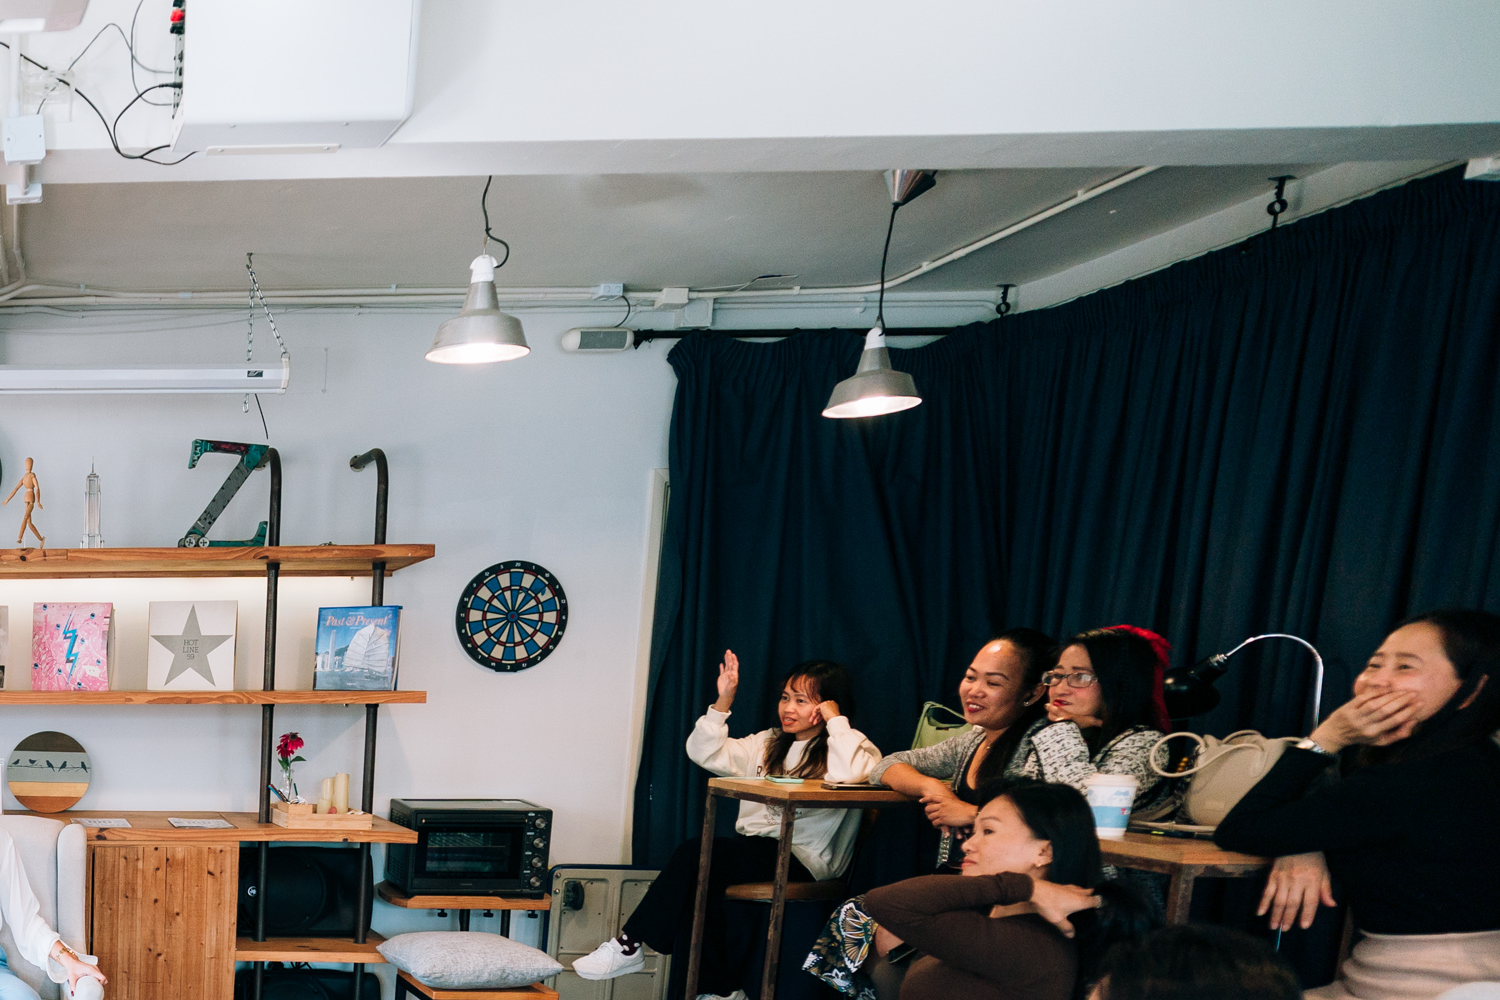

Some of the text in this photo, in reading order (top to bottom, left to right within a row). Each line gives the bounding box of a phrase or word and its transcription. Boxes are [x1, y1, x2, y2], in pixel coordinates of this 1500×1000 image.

[325, 615, 388, 627] Past & Present
[182, 646, 199, 654] LINE
